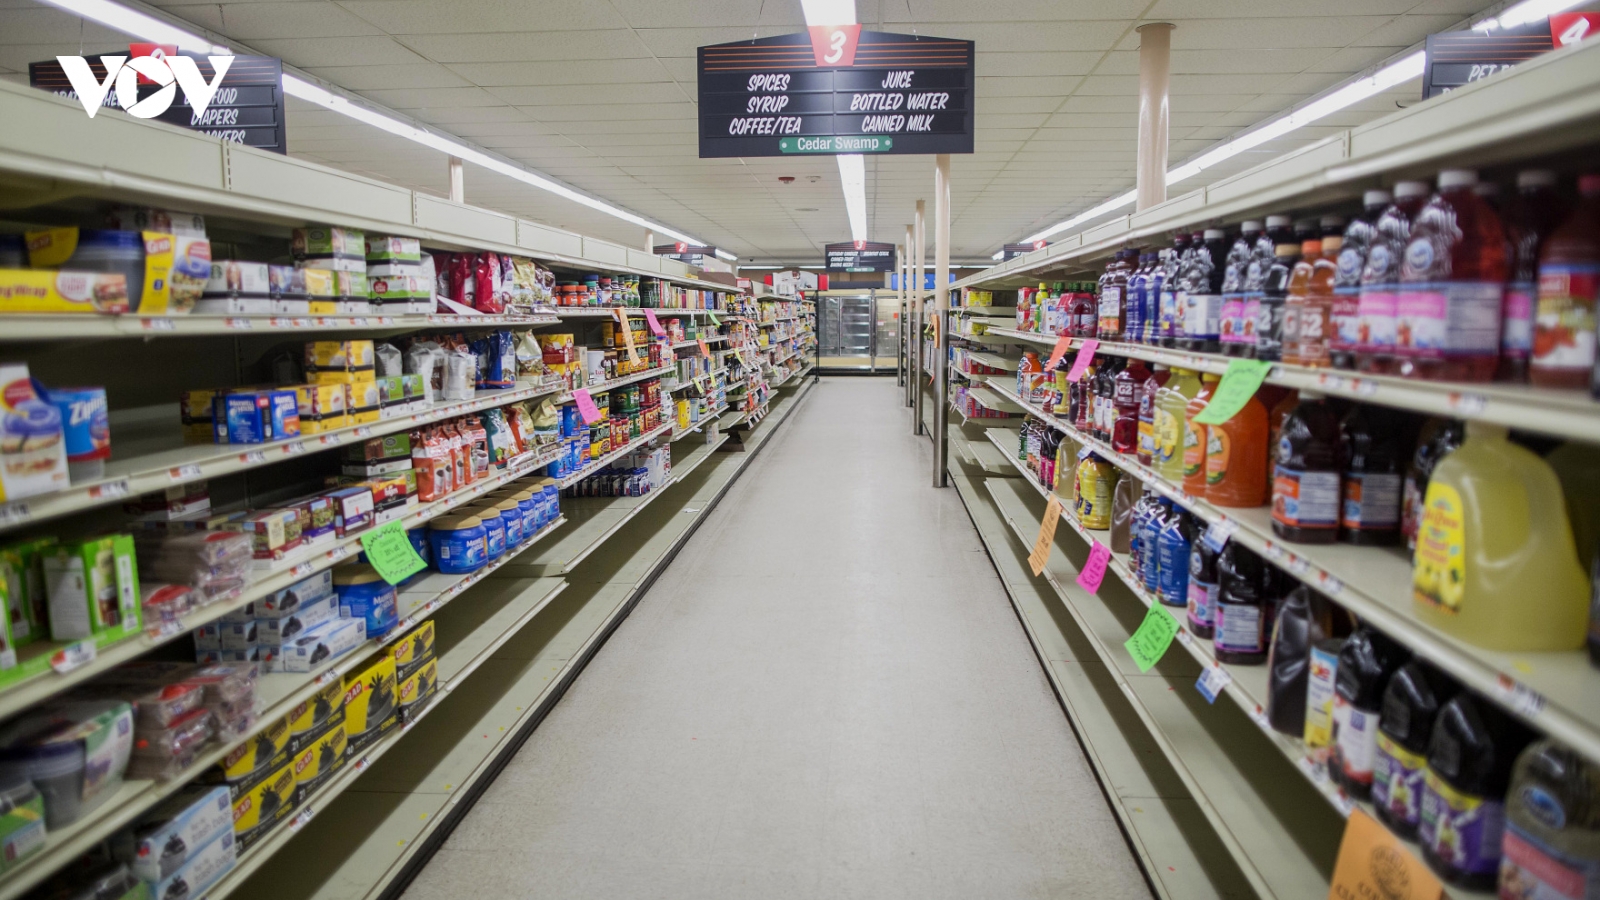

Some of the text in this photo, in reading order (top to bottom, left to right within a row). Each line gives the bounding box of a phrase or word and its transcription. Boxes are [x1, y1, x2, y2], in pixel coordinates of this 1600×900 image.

[1559, 16, 1590, 47] 4
[824, 30, 846, 63] 3
[882, 71, 914, 89] JUICE
[1468, 64, 1498, 82] PET
[747, 74, 791, 92] SPICES
[212, 88, 238, 105] FOOD
[746, 96, 789, 113] SYRUP
[850, 92, 949, 111] BOTTLED WATER
[729, 117, 802, 135] COFFEE/TEA
[861, 114, 933, 132] CANNED MILK
[797, 136, 879, 152] Cedar Swamp
[679, 243, 686, 252] 2
[856, 240, 863, 250] 3
[1118, 385, 1132, 395] G2
[395, 641, 408, 659] GLAD
[401, 680, 414, 698] GLAD
[225, 743, 247, 769] GLAD
[296, 750, 313, 774] GLAD
